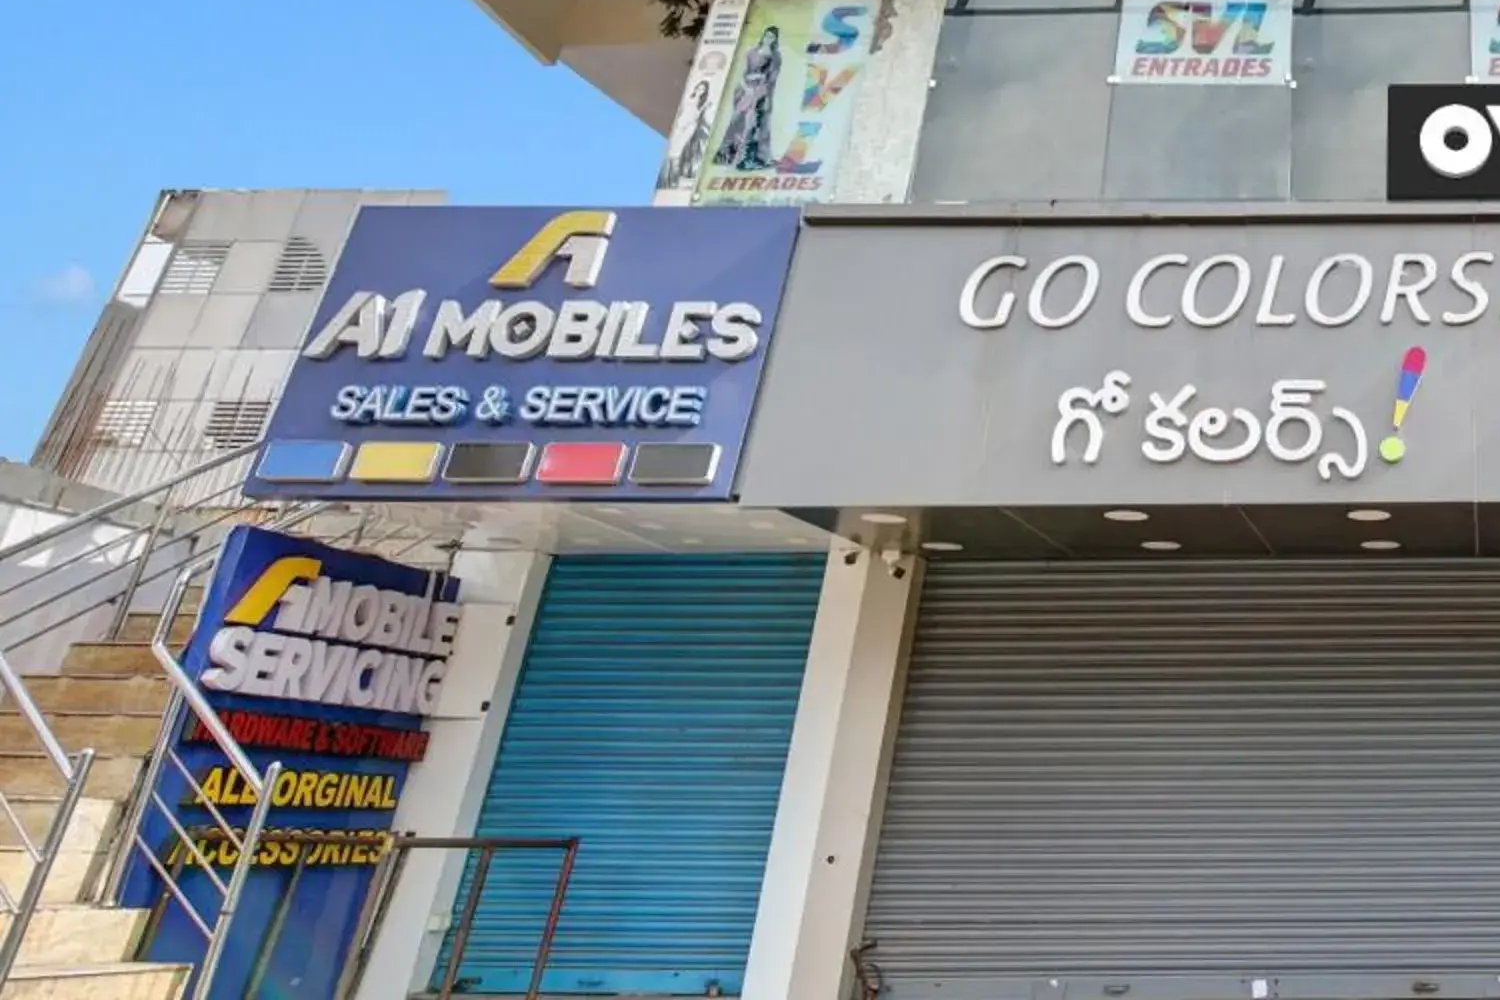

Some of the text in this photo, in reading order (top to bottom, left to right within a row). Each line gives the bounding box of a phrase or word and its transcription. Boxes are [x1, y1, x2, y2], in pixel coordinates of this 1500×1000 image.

[1135, 2, 1276, 55] SVL
[1131, 58, 1272, 78] ENTRADES
[707, 176, 825, 191] ENTRADES
[959, 254, 1099, 328] GO
[423, 300, 764, 361] MOBILES
[331, 385, 704, 425] SALES & SERVICE
[1050, 370, 1131, 464] గో
[302, 576, 459, 657] MOBILE
[200, 627, 447, 715] SERVICING
[271, 772, 396, 809] ORGINAL
